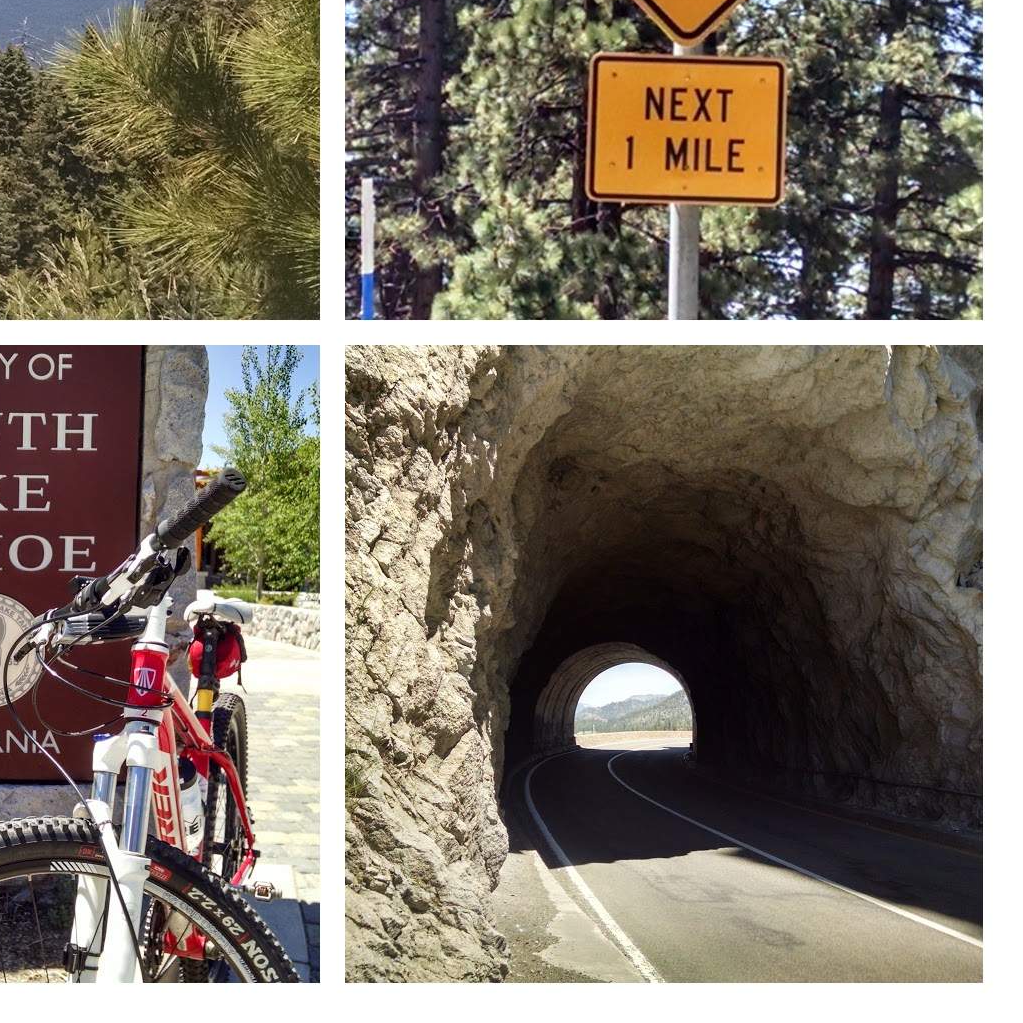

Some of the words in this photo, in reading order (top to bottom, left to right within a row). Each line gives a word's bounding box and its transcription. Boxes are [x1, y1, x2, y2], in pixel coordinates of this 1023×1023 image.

[644, 87, 734, 122] NEXT
[626, 136, 634, 170] 1
[664, 137, 745, 173] MILE
[28, 353, 73, 380] OF
[152, 767, 177, 845] REK
[241, 940, 281, 983] SON
